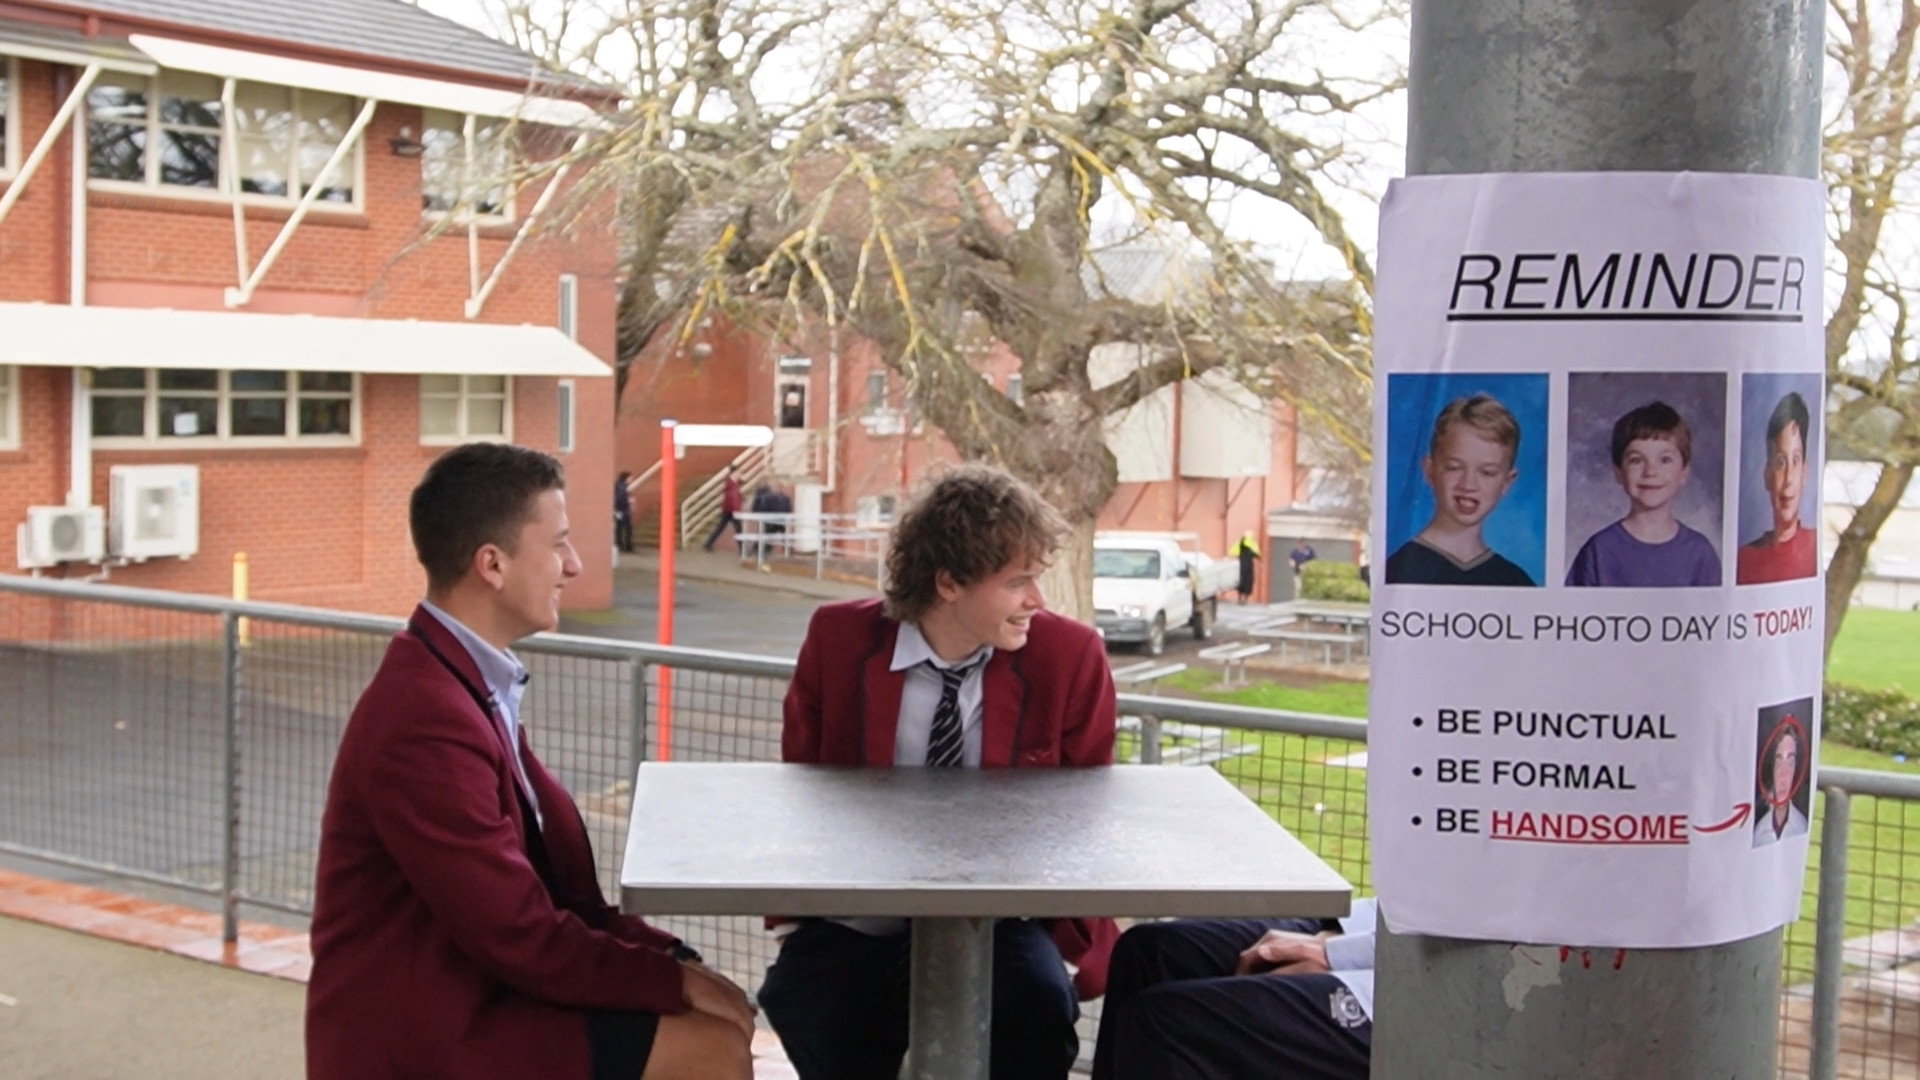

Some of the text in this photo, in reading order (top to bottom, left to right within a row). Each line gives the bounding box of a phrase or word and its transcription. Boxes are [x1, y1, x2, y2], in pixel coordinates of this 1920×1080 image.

[1448, 253, 1805, 310] REMINDER
[1380, 606, 1813, 643] SCHOOL PHOTO DAY IS TODAY!
[1437, 709, 1677, 739] BE PUNCTUAL
[1436, 759, 1637, 790] BE FORMAL
[1436, 808, 1689, 841] BE HANDSOME
